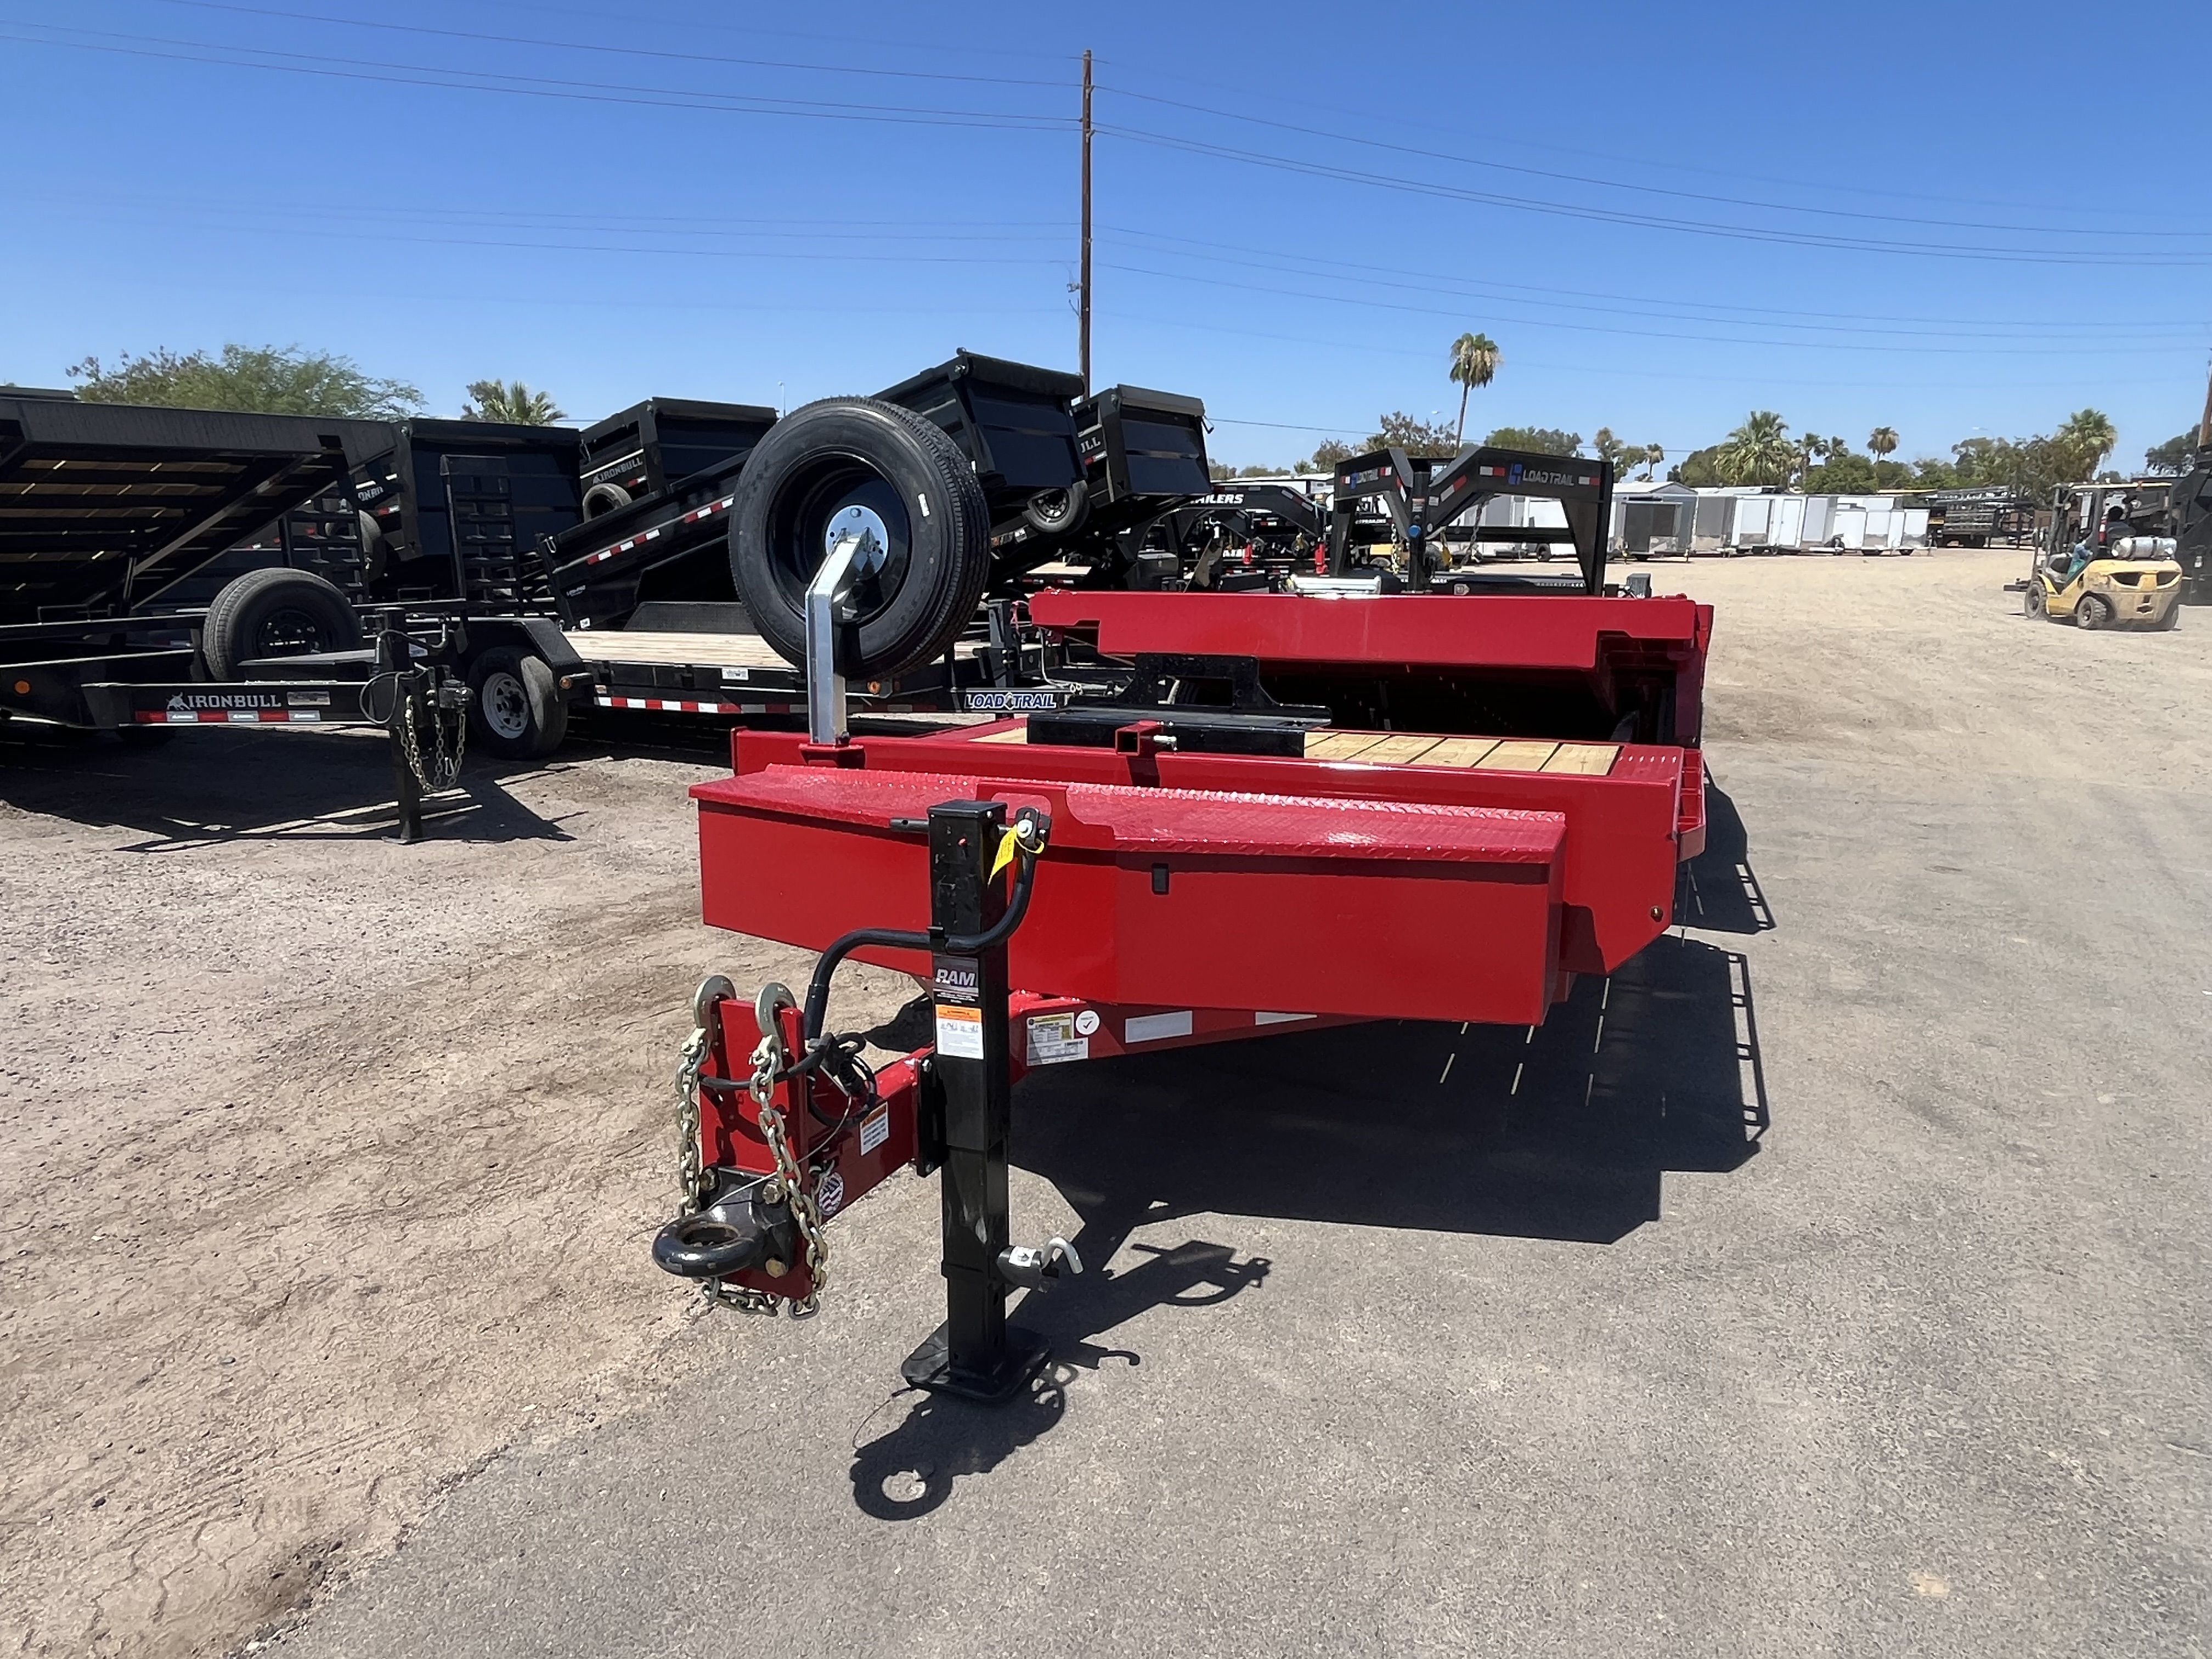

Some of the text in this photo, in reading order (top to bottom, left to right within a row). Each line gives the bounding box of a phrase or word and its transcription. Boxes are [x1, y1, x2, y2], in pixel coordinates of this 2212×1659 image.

[600, 457, 643, 482] IRONBULL
[187, 695, 282, 708] IRONBULL
[964, 693, 1057, 709] LOAD TRAIL
[935, 968, 975, 986] RAM
